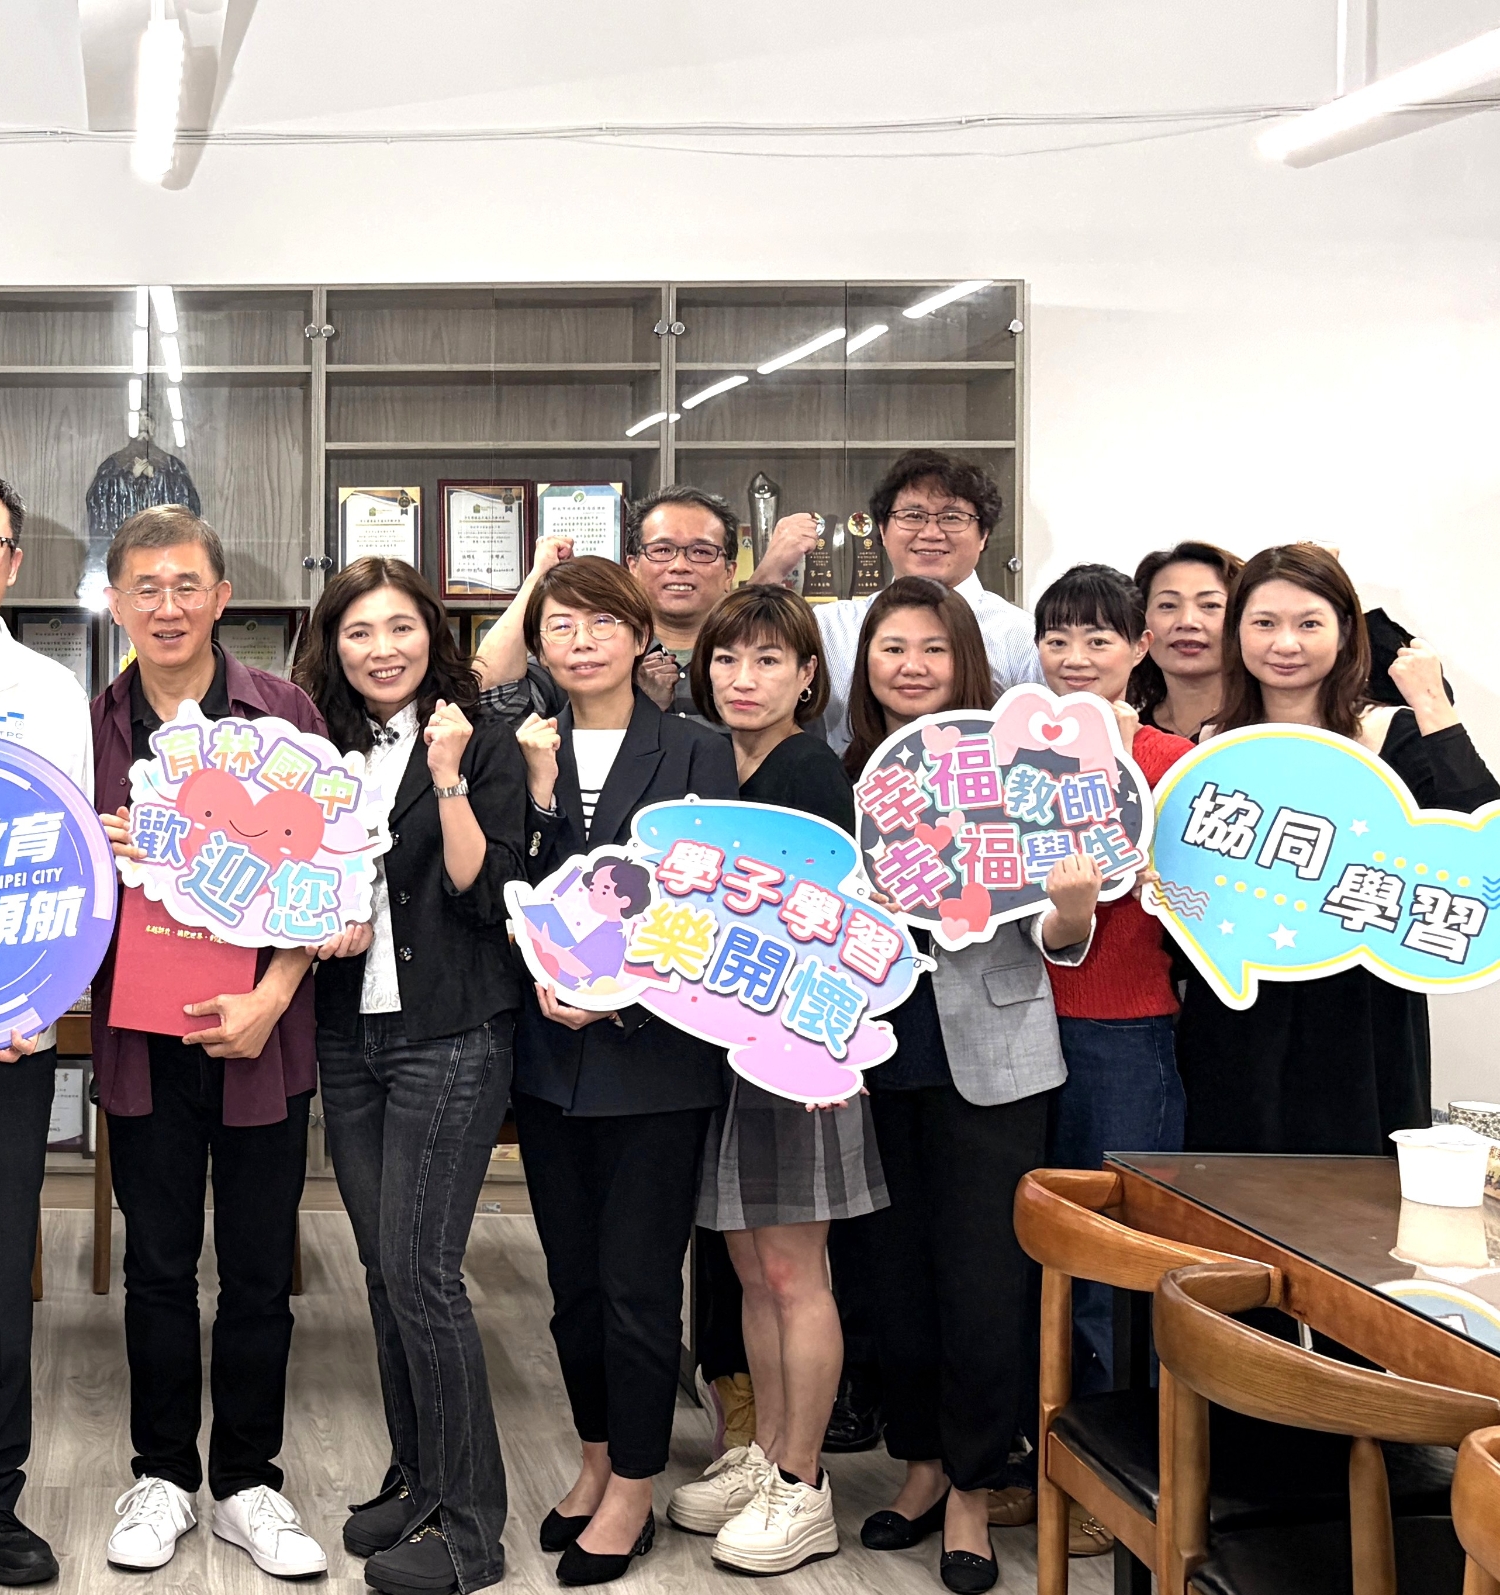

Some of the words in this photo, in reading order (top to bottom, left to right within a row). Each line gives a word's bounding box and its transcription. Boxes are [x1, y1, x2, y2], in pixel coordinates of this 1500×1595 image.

[157, 724, 357, 819] 育林國中
[856, 735, 1112, 833] 幸福教師
[31, 867, 64, 886] CITY
[135, 807, 337, 938] 歡迎您
[874, 822, 1142, 911] 幸福學生
[1182, 781, 1336, 880] 協同
[657, 840, 902, 982] 學子學習
[1322, 863, 1488, 965] 學習
[627, 902, 870, 1058] 樂開懷
